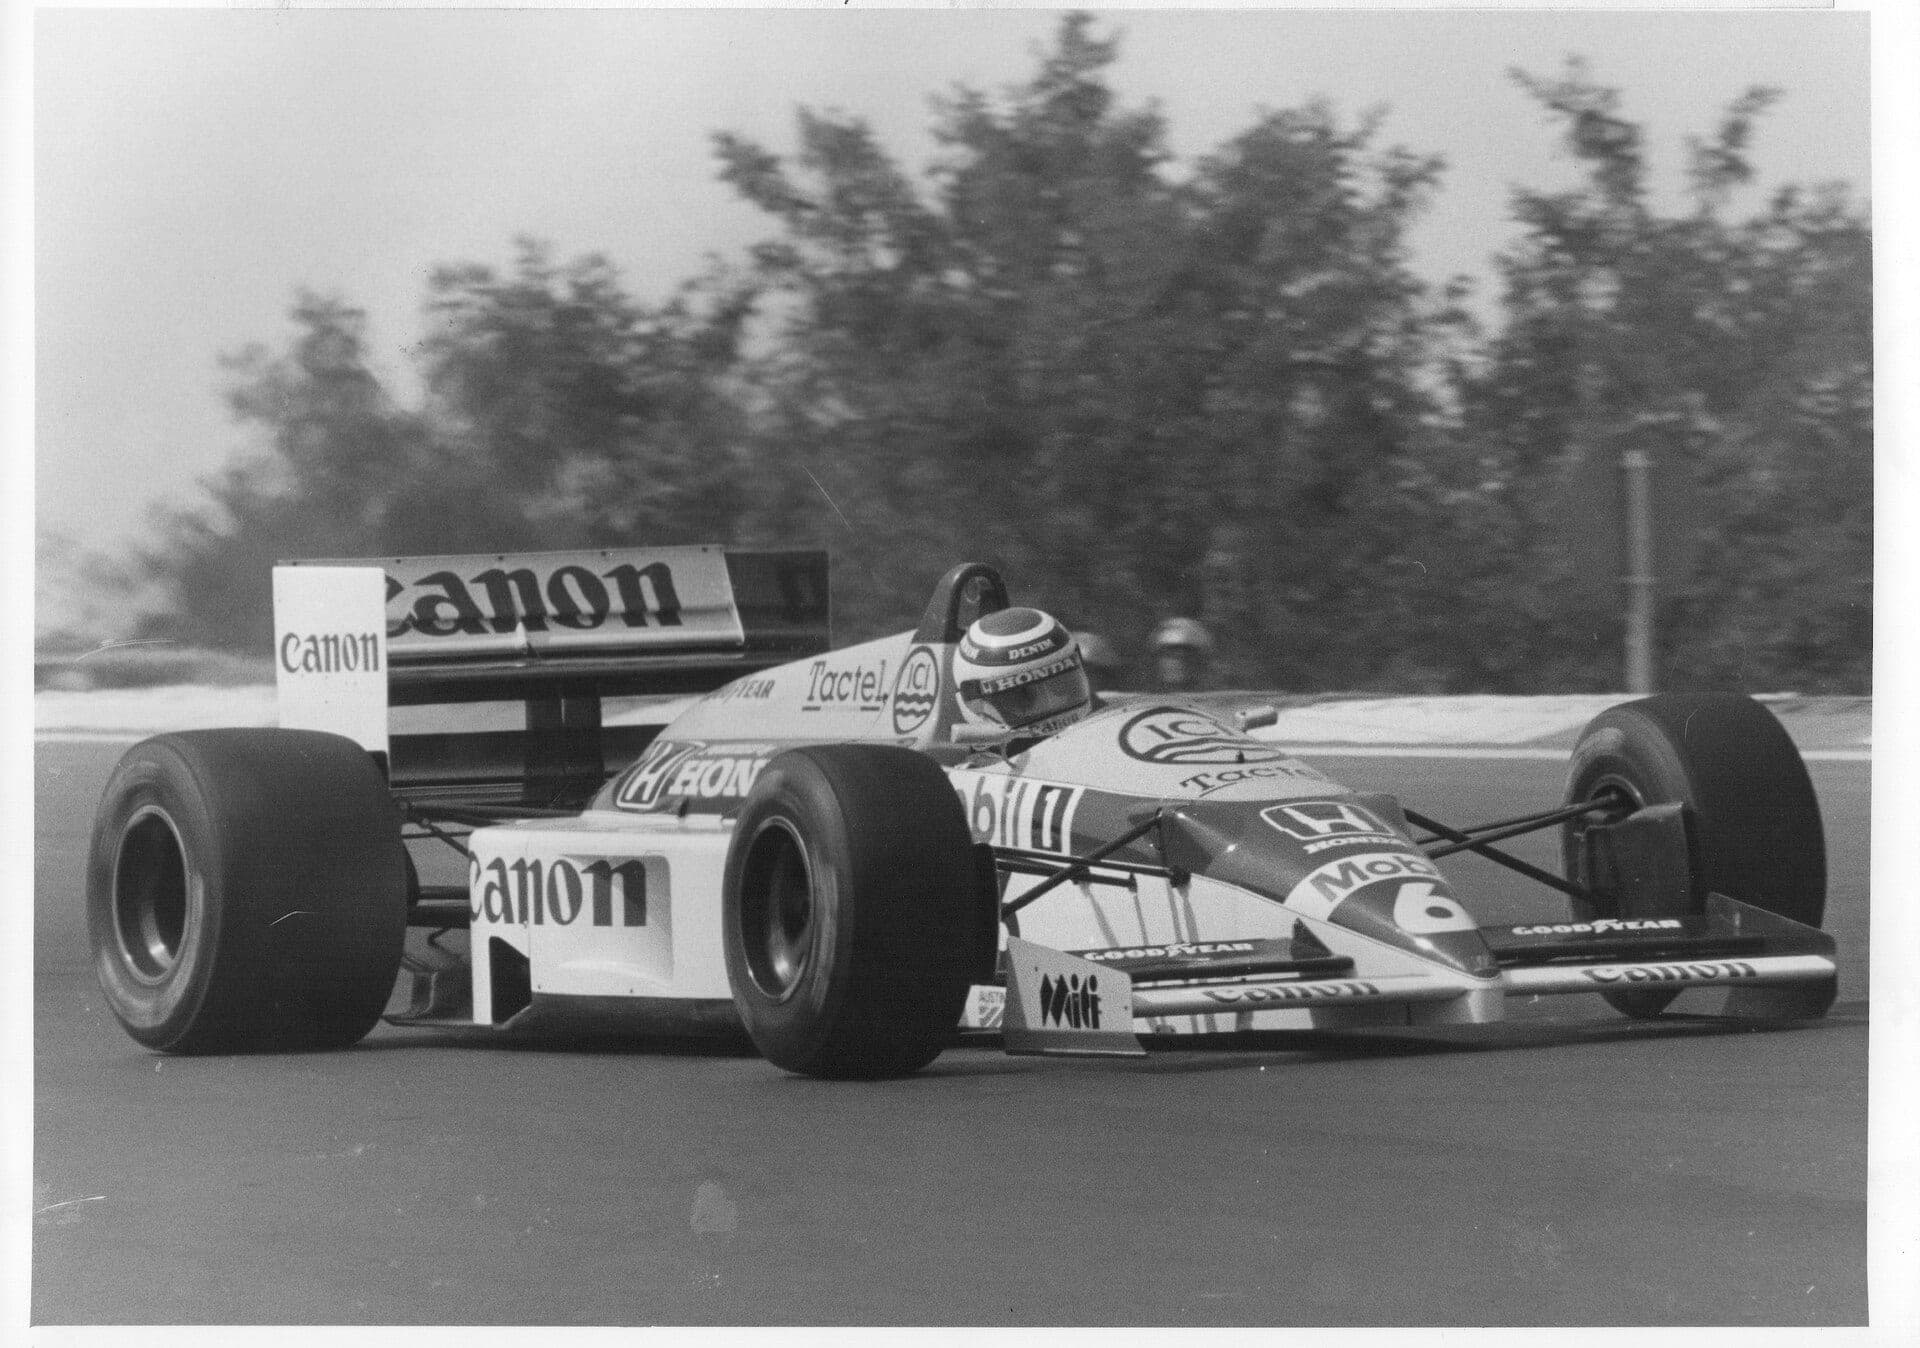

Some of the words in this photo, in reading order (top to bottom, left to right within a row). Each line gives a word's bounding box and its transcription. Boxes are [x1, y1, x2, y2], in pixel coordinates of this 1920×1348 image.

[281, 632, 378, 673] Canon
[807, 660, 887, 703] Tactel
[907, 662, 931, 690] ICI
[1393, 882, 1478, 937] 6
[1582, 961, 1758, 983] Canon
[1203, 980, 1380, 1004] Canon
